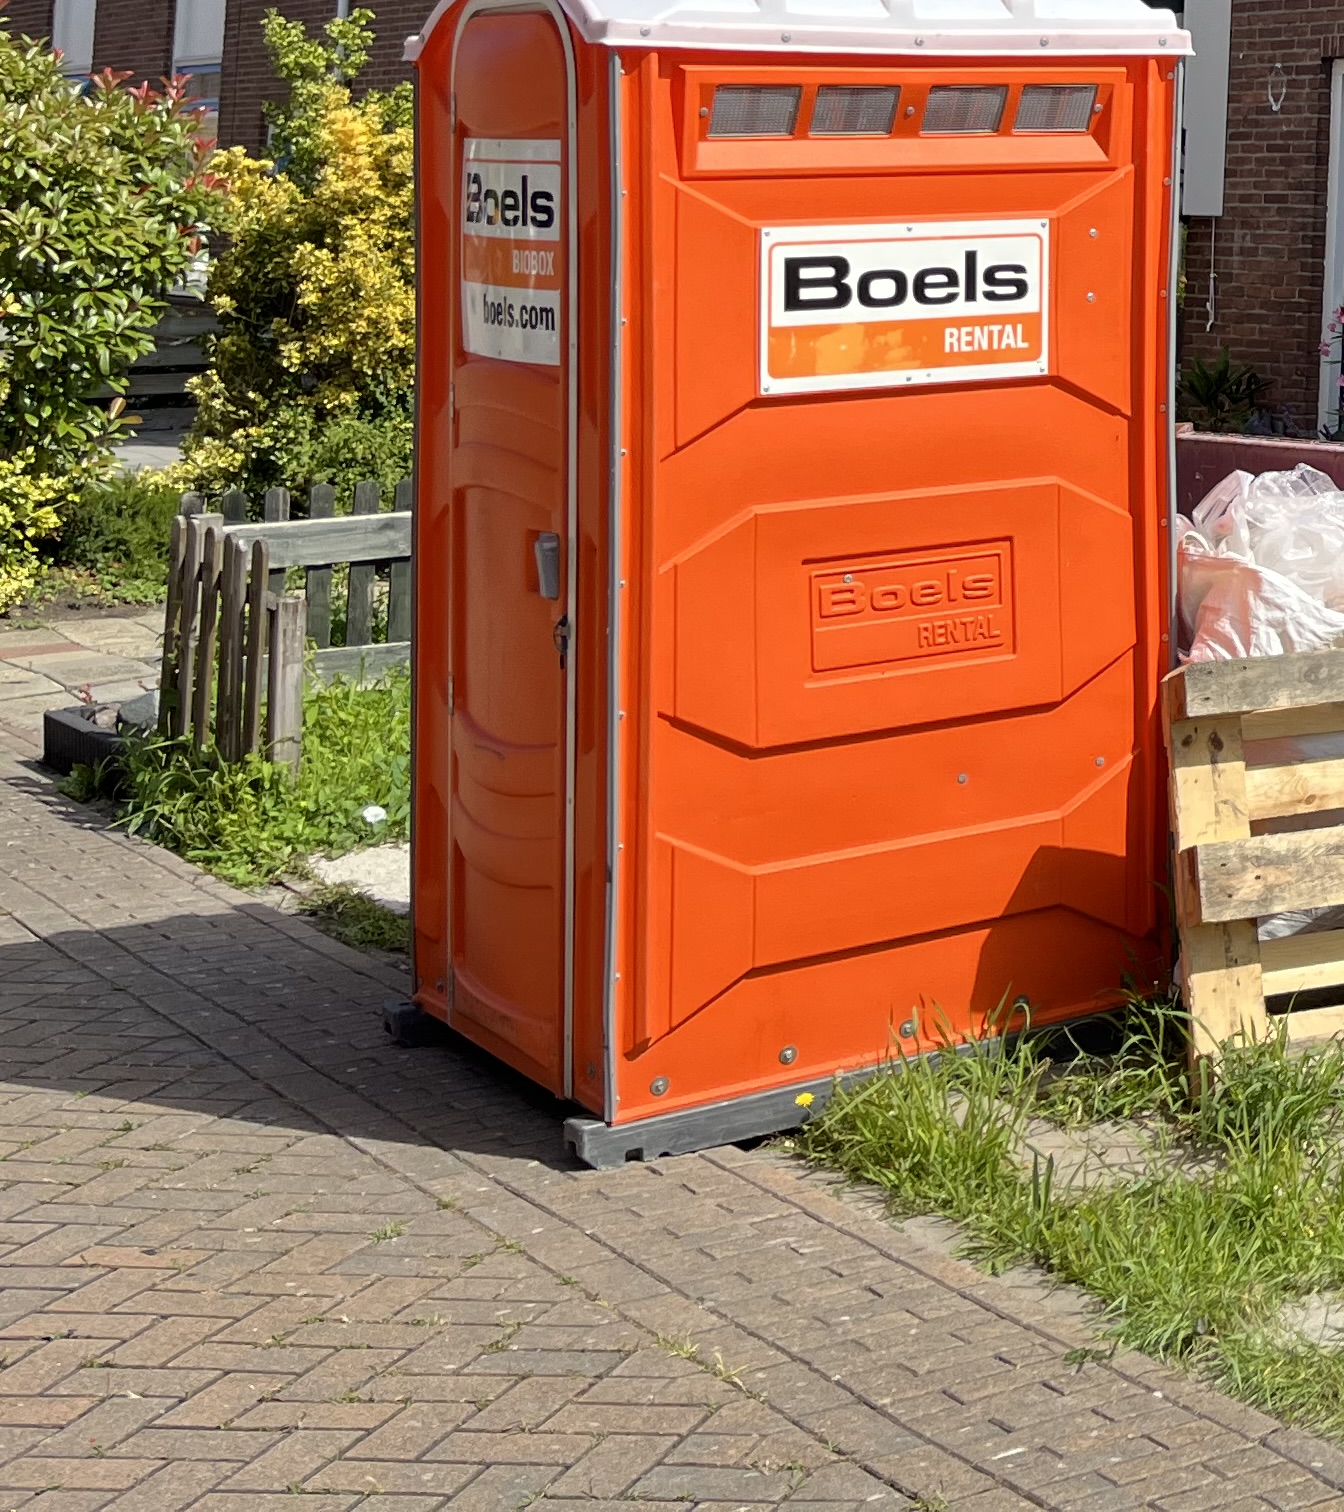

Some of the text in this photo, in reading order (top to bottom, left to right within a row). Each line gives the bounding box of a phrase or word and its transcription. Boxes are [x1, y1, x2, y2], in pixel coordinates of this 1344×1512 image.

[467, 172, 554, 228] Boels
[512, 249, 554, 276] BIOBOX
[784, 250, 1029, 312] Boels
[483, 293, 555, 331] boels.com
[944, 324, 1029, 353] RENTAL
[819, 569, 994, 619] Boels
[918, 614, 1001, 648] RENTAL
